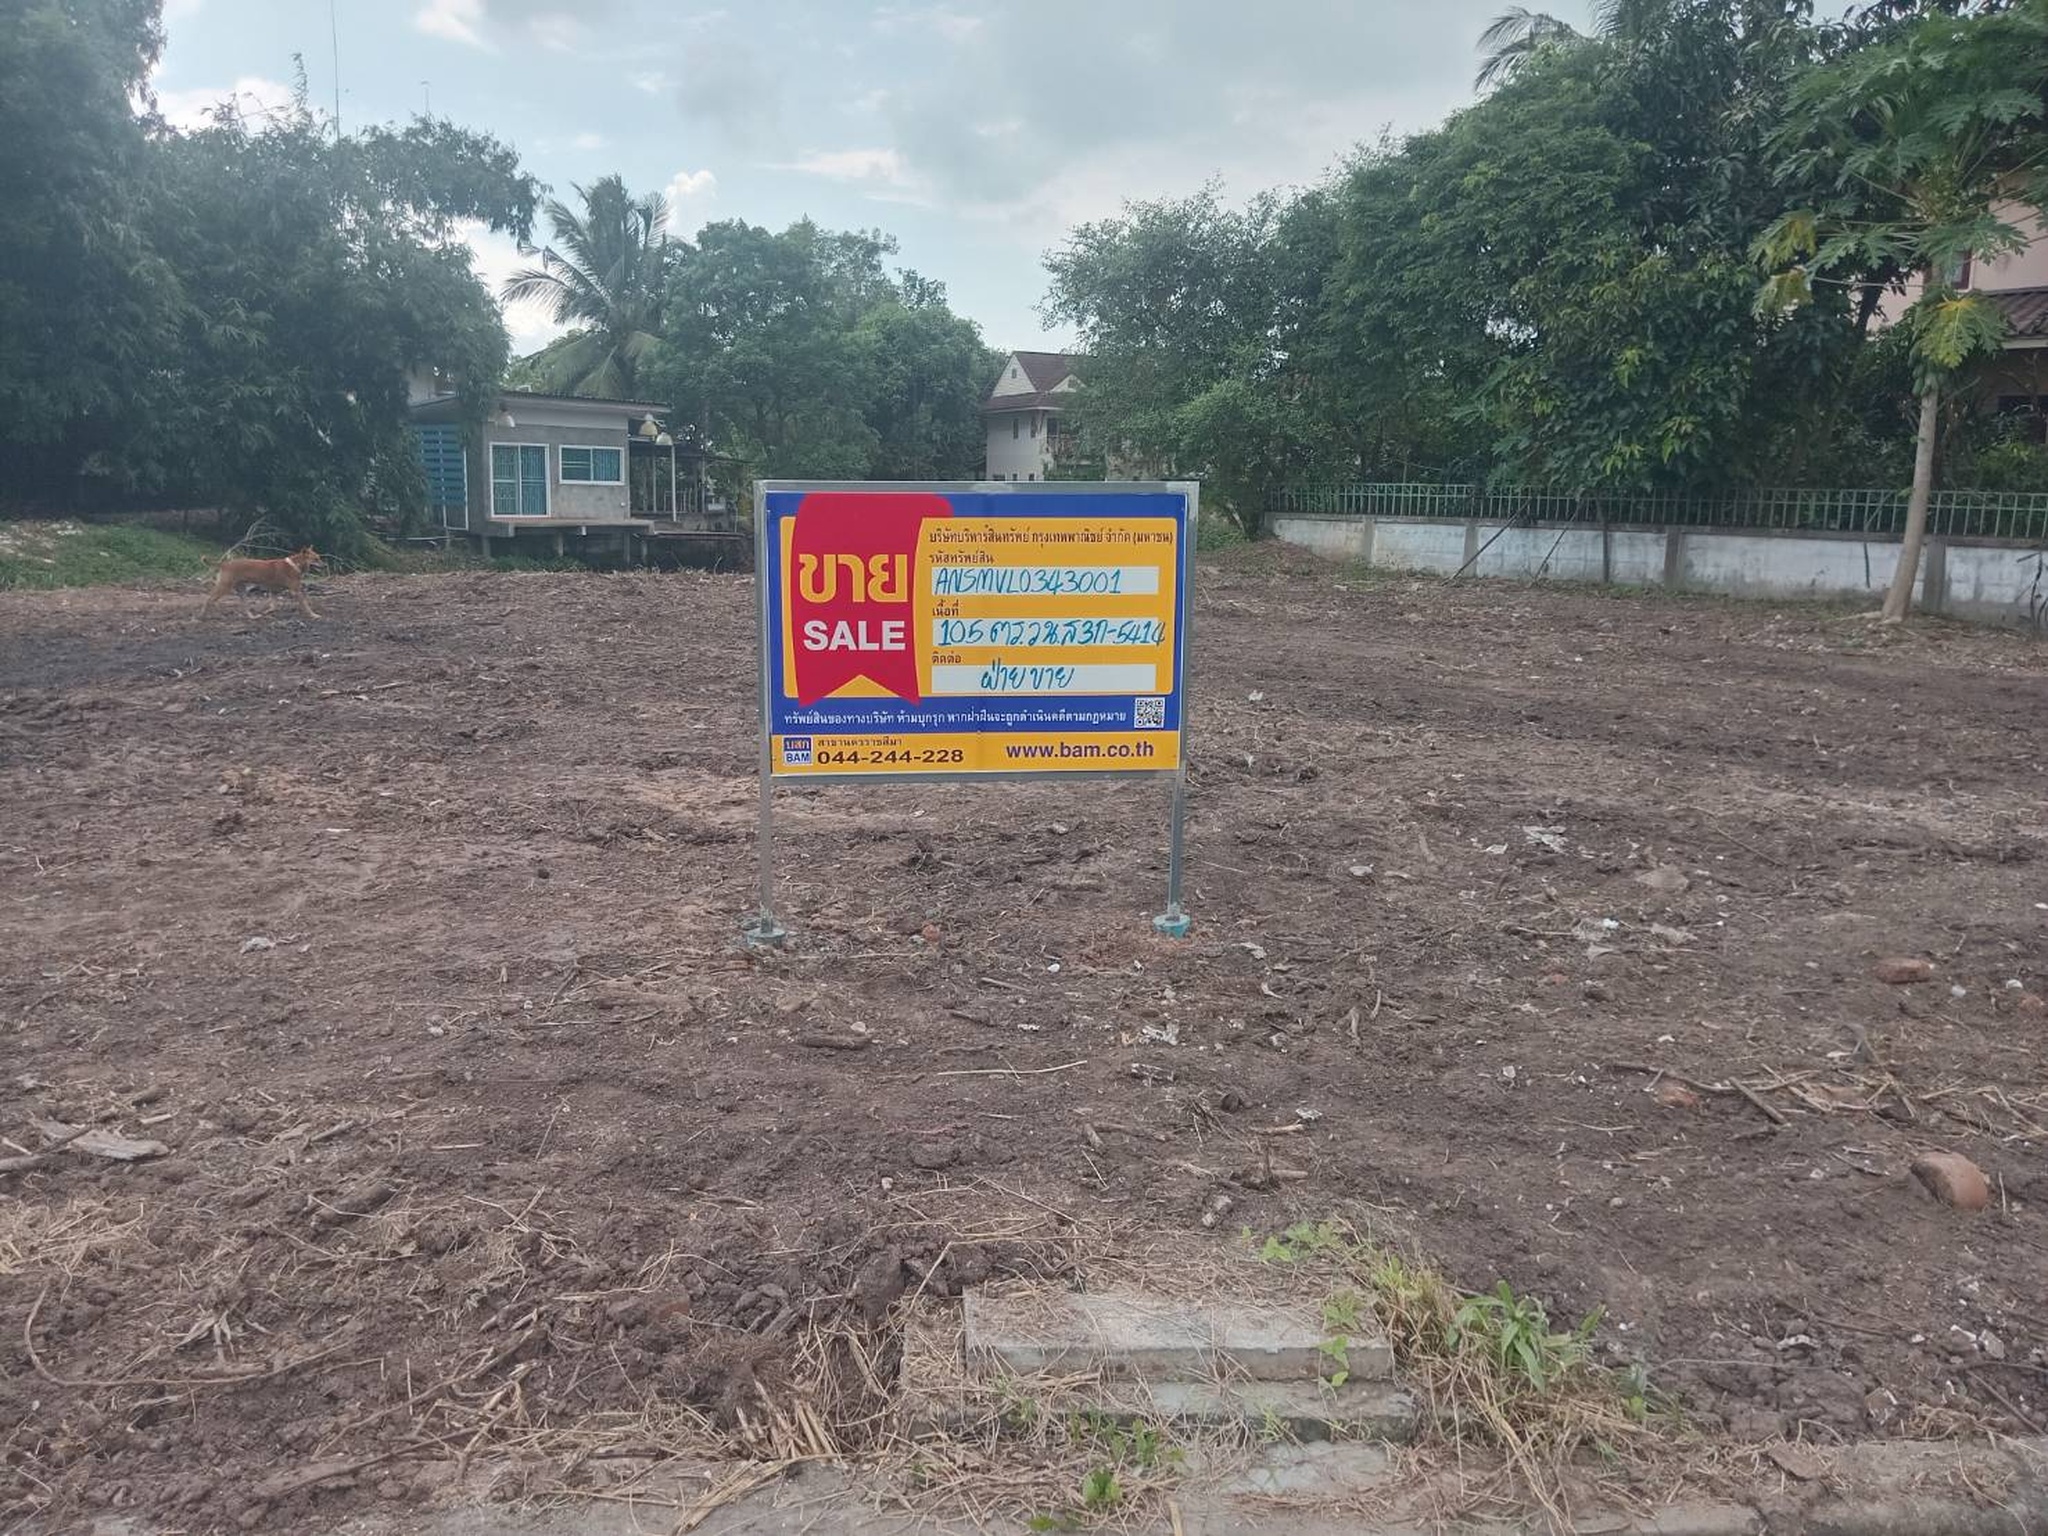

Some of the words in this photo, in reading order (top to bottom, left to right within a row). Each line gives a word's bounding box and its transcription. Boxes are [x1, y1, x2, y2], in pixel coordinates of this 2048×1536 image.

[1105, 528, 1131, 544] จำกัด
[1132, 530, 1173, 545] (มหาชน)
[929, 550, 994, 564] รหัสทรัพย์สิน
[798, 554, 908, 602] ขาย
[932, 599, 959, 617] เนื้อที่
[803, 620, 906, 651] SALE
[938, 619, 983, 646] 105
[931, 650, 962, 664] ติดต่อ
[896, 709, 945, 727] ห้ามบุกรุก
[785, 752, 811, 764] BAM
[817, 749, 964, 765] 044-244-228
[1006, 741, 1154, 758] www.bam.co.th
